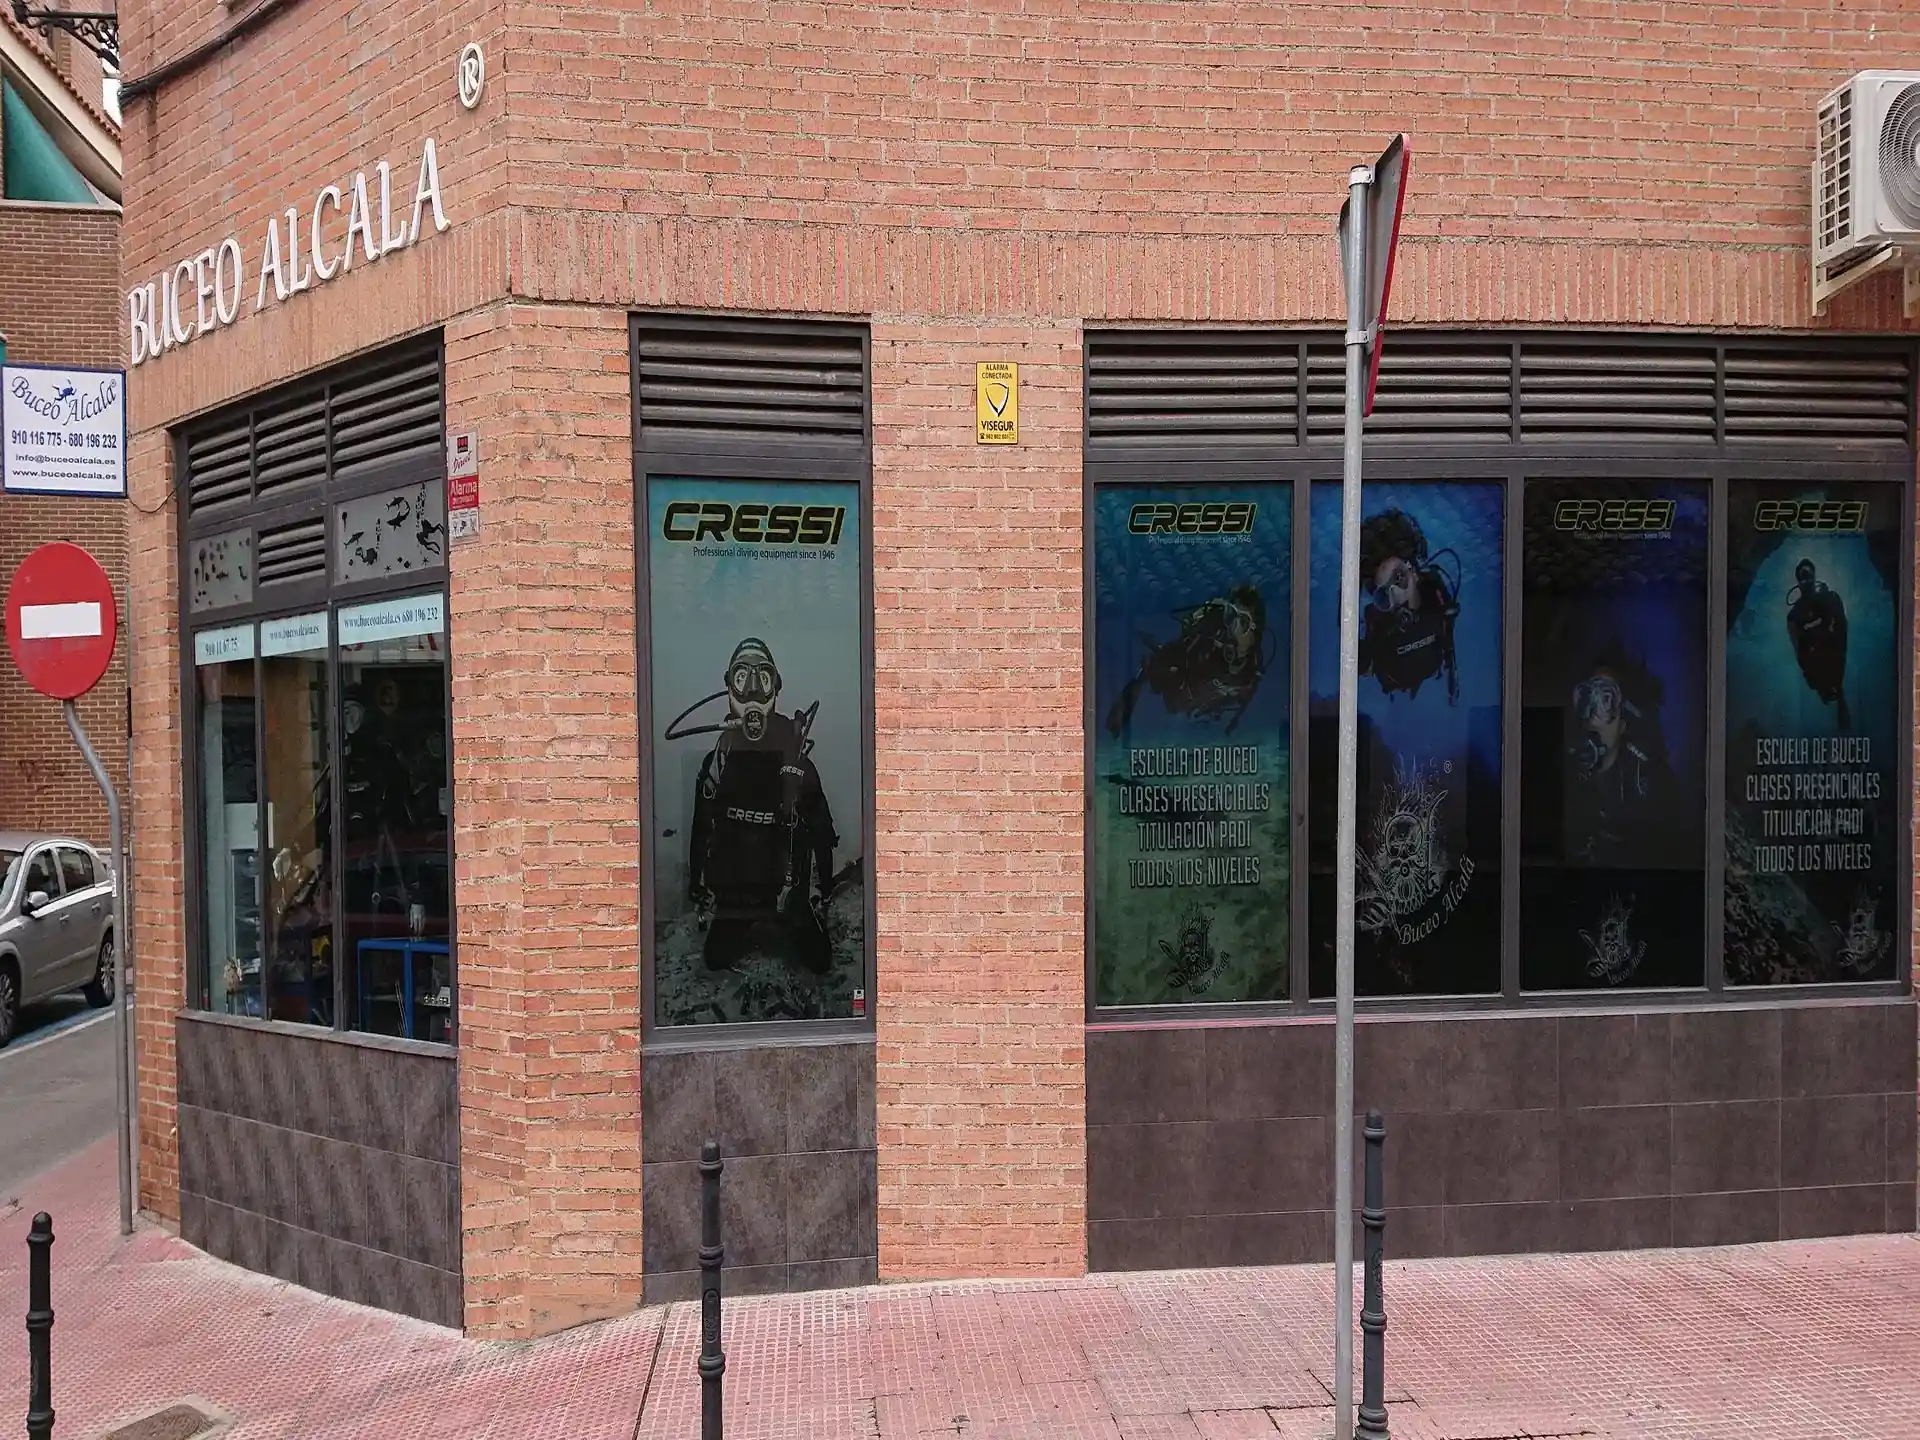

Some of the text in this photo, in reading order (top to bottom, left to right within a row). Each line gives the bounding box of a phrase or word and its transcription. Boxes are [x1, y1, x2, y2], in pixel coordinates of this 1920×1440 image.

[128, 137, 451, 366] BUCEO ALCALA
[981, 372, 1013, 380] CONECTADA
[12, 376, 61, 420] Buceo
[12, 430, 27, 444] 910
[30, 431, 45, 445] 116
[47, 432, 61, 446] 775
[69, 433, 83, 447] 680
[86, 433, 100, 448] 196
[102, 434, 117, 448] 232
[981, 420, 1015, 431] VISEGUR
[16, 454, 116, 465] info@buceoalcala.es
[12, 470, 117, 480] www.buceoalcala.es
[451, 480, 477, 499] Alarma
[663, 500, 847, 546] CRESSI
[1128, 503, 1257, 535] CRESSI
[1555, 500, 1676, 531] CRESSI
[1754, 500, 1869, 531] CRESSI
[694, 546, 835, 560] Professional diving equipment since 1946
[427, 606, 438, 620] 232
[1131, 746, 1258, 776] ESCUELA DE BUCEO
[1757, 737, 1871, 765] ESCUELA DE BUCEO
[1119, 783, 1269, 813] CLASES PRESENCIALES
[1746, 772, 1881, 802] CLASES PRESENCIALES
[1138, 814, 1251, 851] TITULACIÓN PADI
[1763, 803, 1864, 837] TITULACIÓN PADI
[1129, 856, 1260, 888] TODOS LOS NIVELES
[1755, 843, 1871, 872] TODOS LOS NIVELES
[1400, 911, 1440, 944] Buceo
